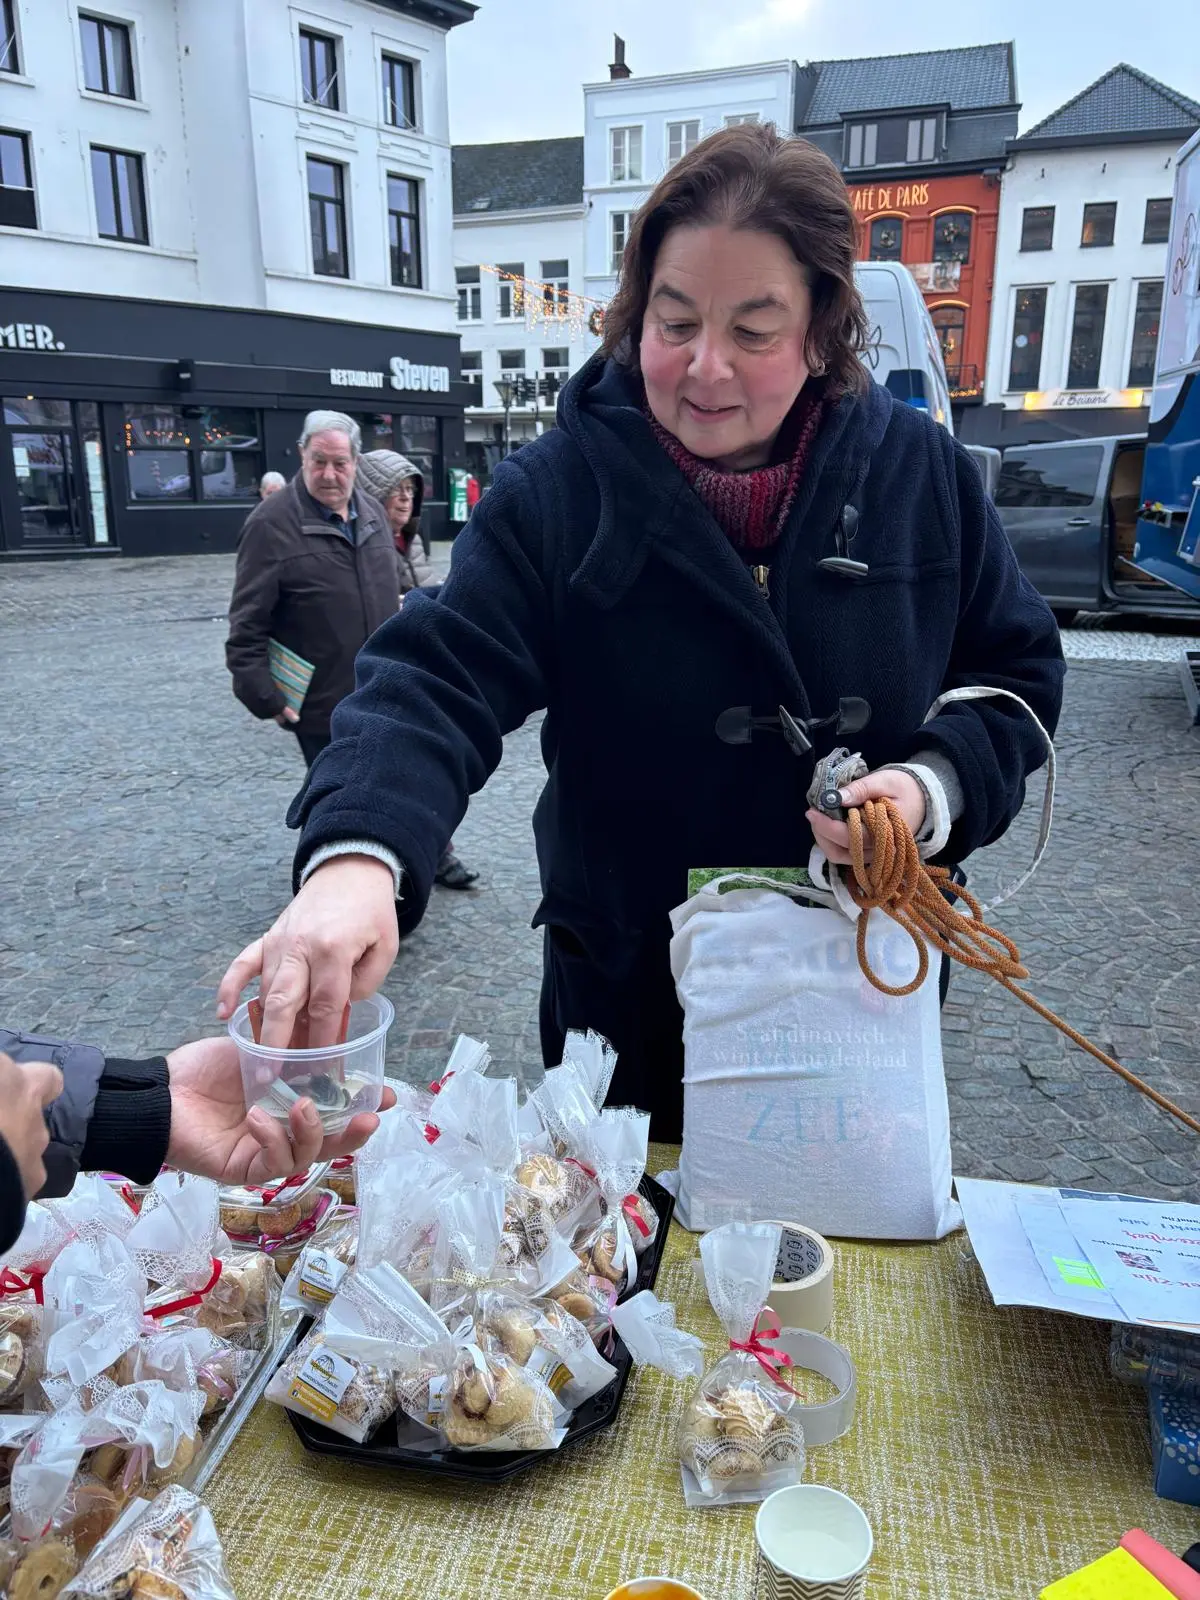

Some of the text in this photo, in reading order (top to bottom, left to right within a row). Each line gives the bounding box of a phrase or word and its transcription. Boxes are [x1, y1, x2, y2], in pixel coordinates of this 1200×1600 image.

[878, 187, 893, 210] DE
[896, 183, 929, 207] PARIS
[390, 356, 450, 392] Steven
